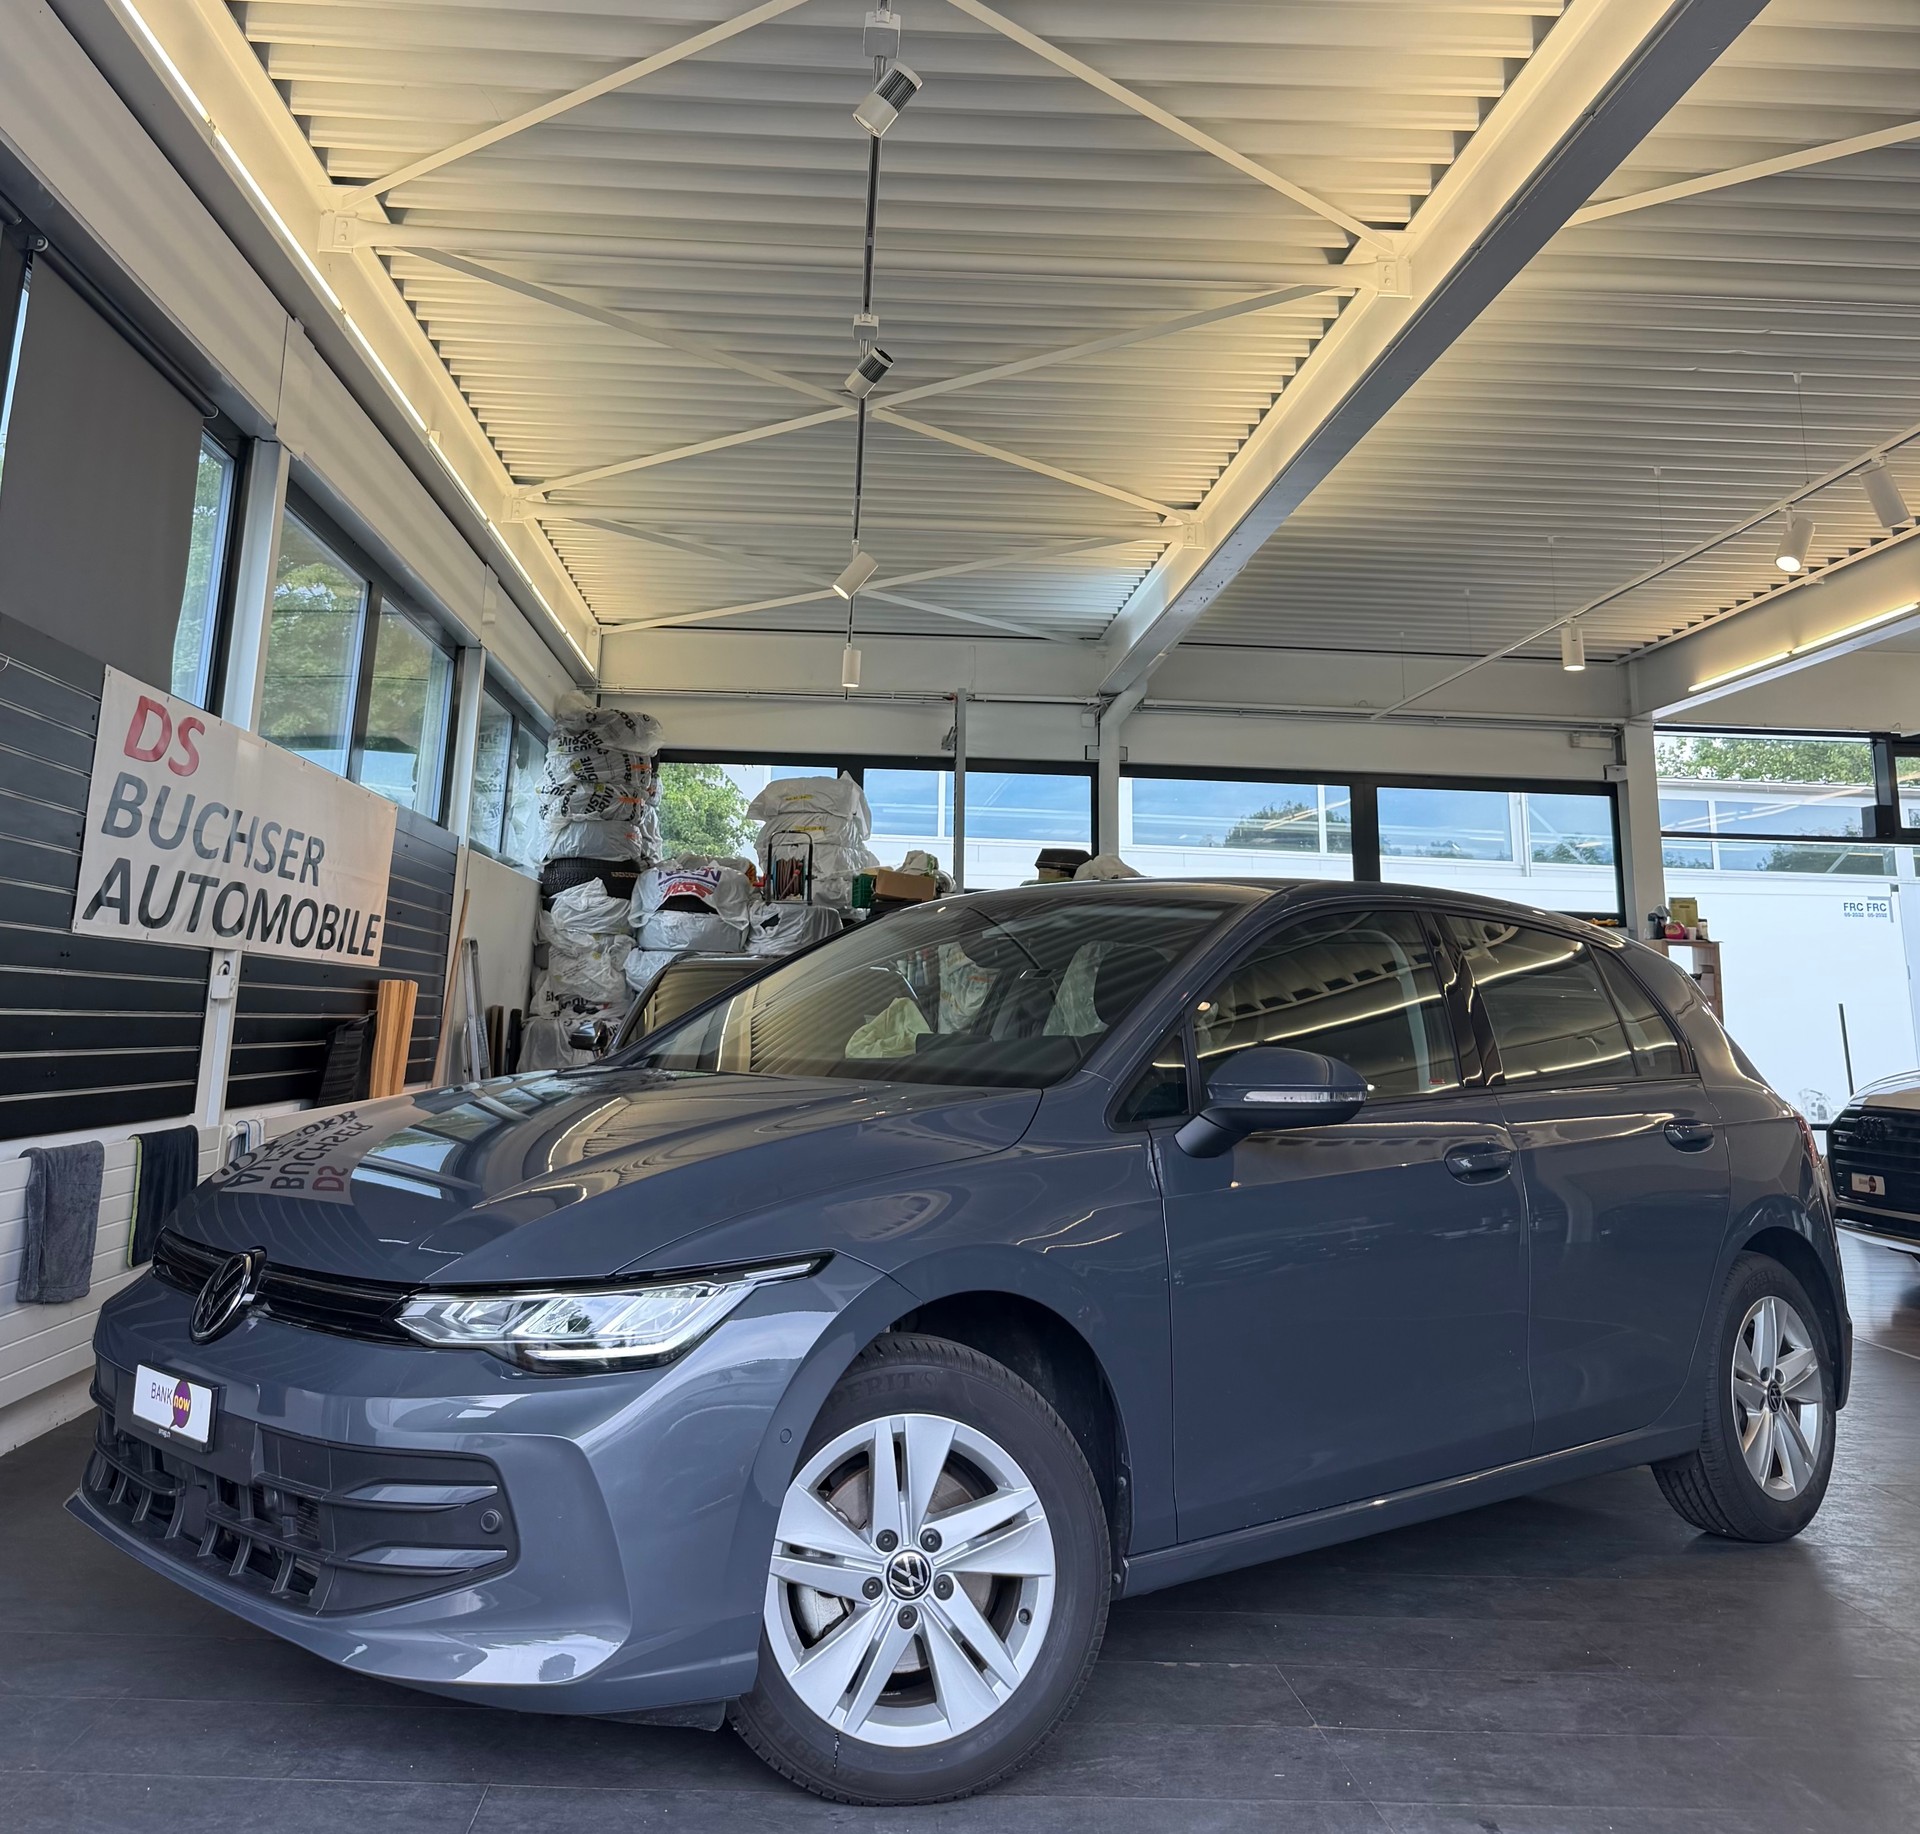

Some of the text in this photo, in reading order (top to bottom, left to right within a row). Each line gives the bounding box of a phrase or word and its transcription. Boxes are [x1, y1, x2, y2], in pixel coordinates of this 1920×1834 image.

[124, 695, 205, 777] DS
[101, 771, 326, 887] BUCHSER
[82, 857, 382, 957] AUTOMOBILE
[1843, 902, 1887, 912] FRC FRC
[150, 1382, 173, 1406] BANK
[174, 1395, 190, 1412] now
